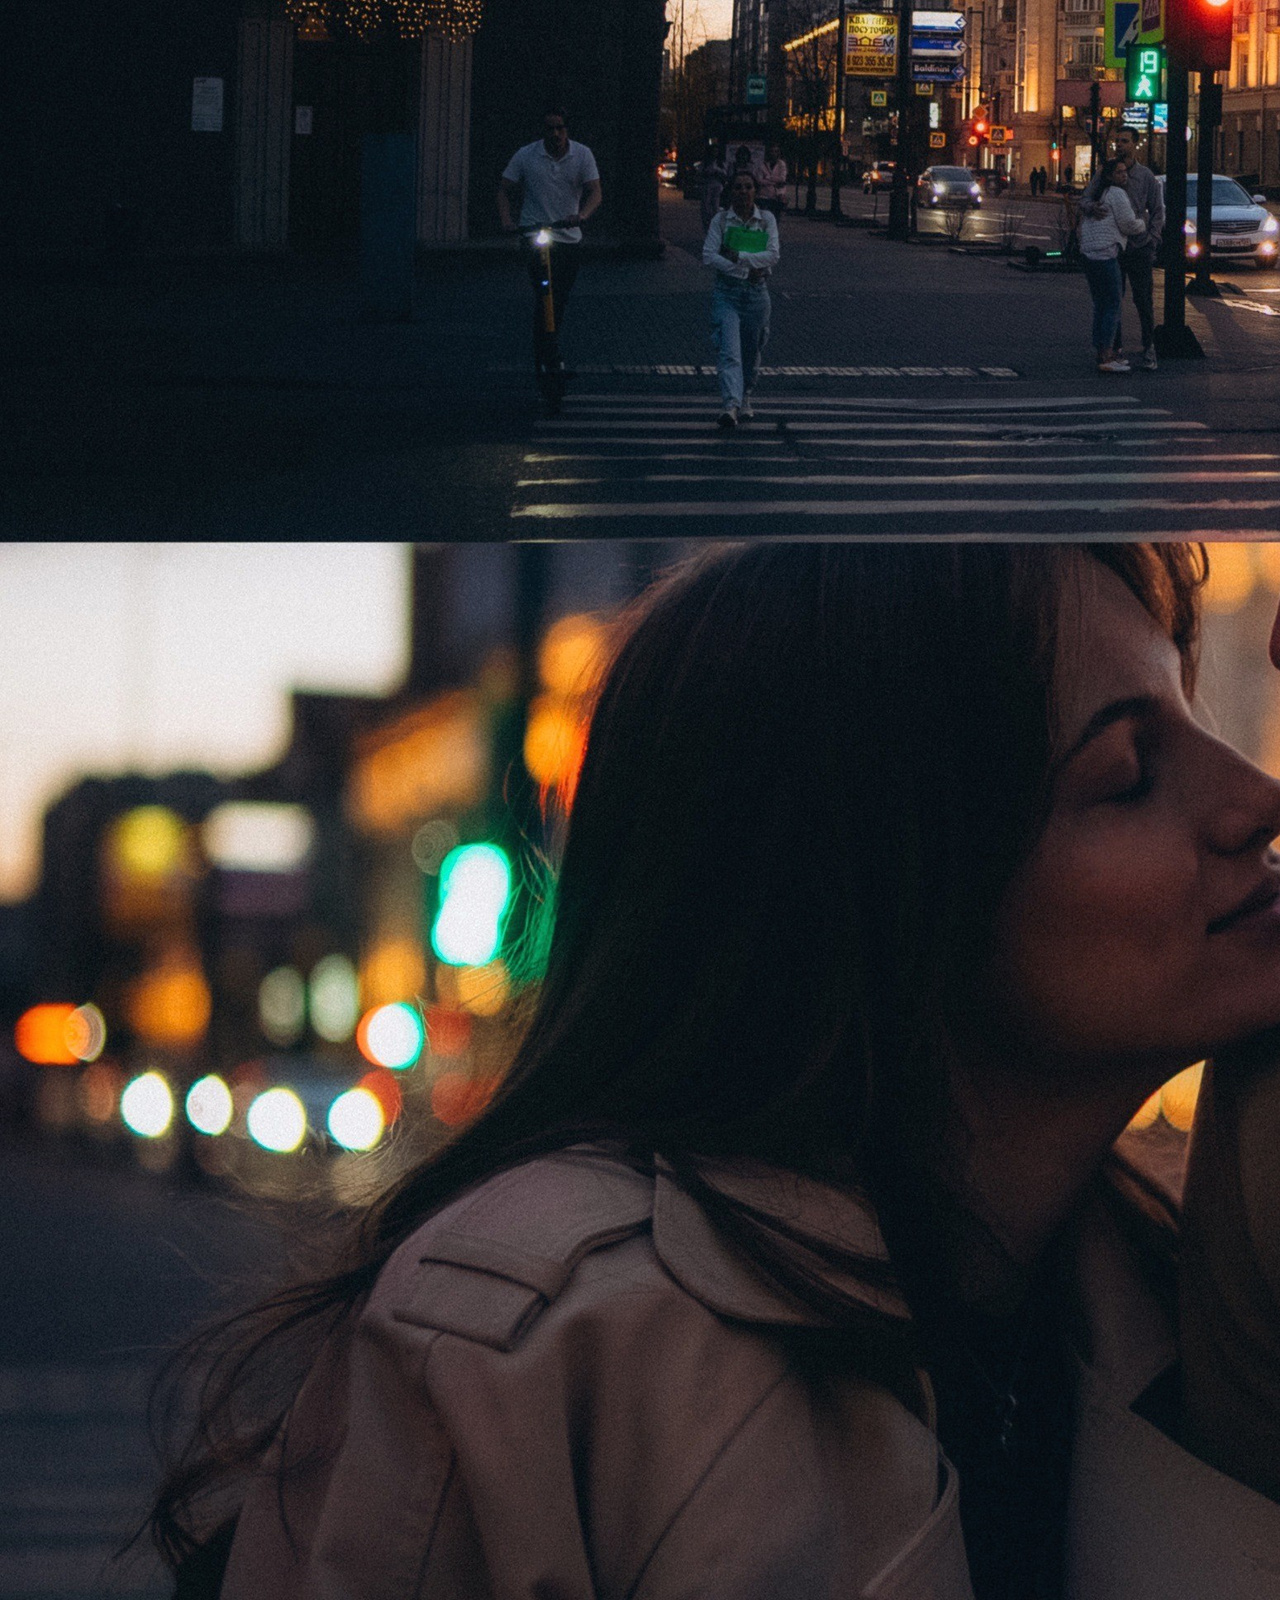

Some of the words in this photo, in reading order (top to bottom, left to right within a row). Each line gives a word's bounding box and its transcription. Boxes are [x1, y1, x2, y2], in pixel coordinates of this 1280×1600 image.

[849, 26, 895, 35] ПОСУТОЧНО
[1140, 50, 1158, 74] 19
[914, 64, 950, 73] Baldinini
